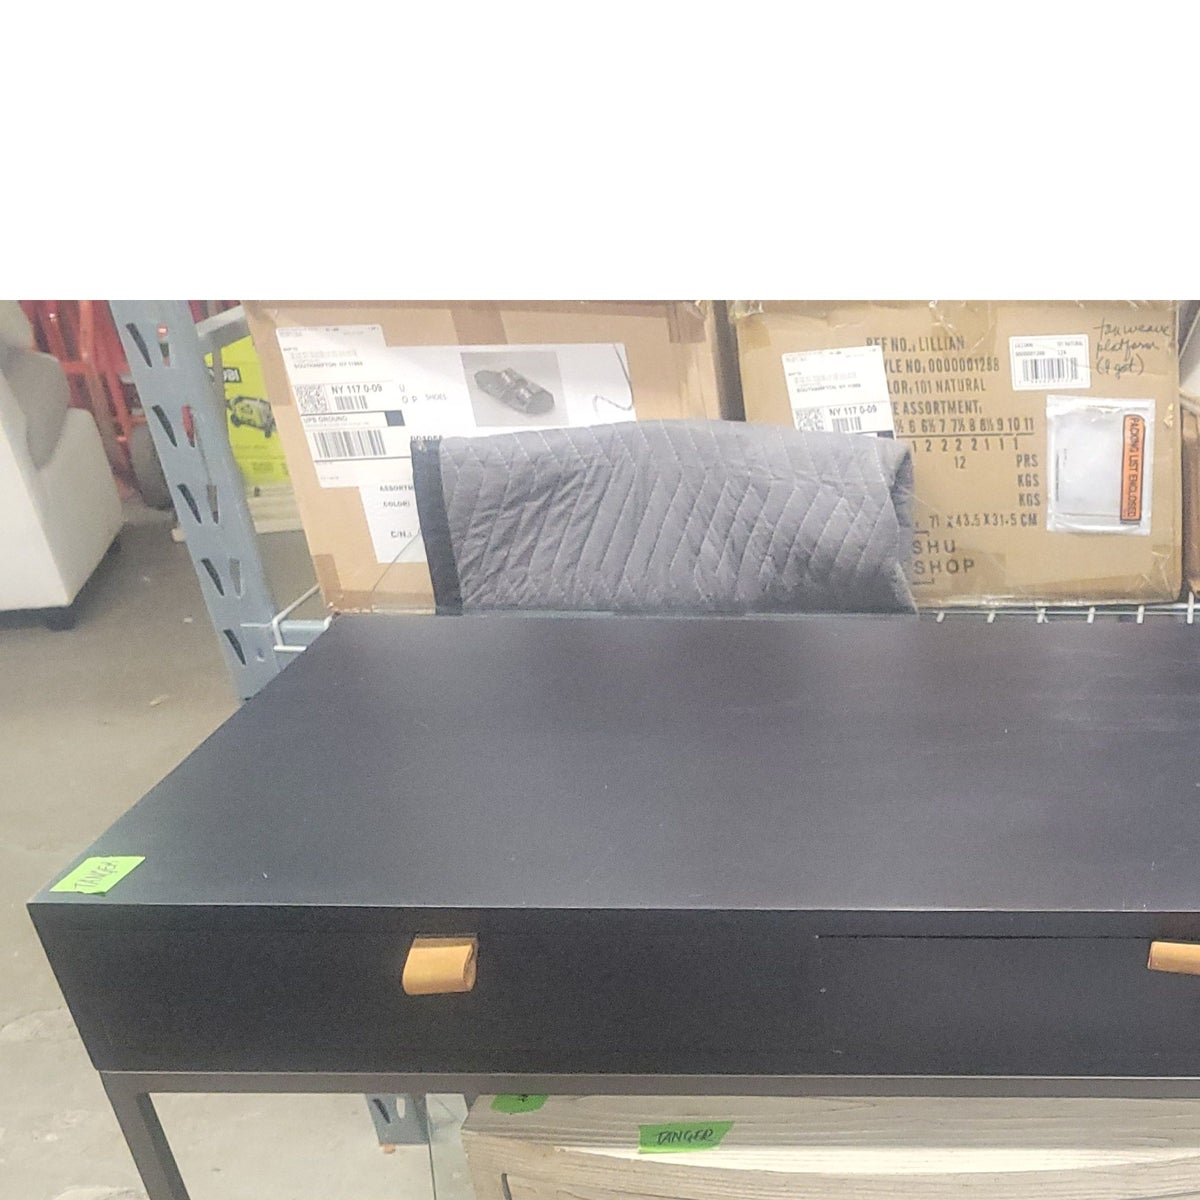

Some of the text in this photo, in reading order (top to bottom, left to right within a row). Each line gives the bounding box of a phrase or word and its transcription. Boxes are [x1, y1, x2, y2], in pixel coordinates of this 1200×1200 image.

[919, 336, 965, 351] LILLIAN
[332, 386, 344, 394] NY
[915, 381, 932, 395] 101
[936, 379, 986, 393] NATURAL
[829, 408, 841, 416] NY
[909, 420, 916, 433] 6
[939, 419, 946, 432] 7
[997, 418, 1004, 431] 9
[1008, 417, 1020, 431] 10
[1025, 417, 1034, 431] 11
[926, 439, 932, 452] 2
[942, 439, 948, 452] 2
[955, 438, 962, 451] 2
[971, 438, 978, 451] 2
[954, 454, 1038, 469] 12 PRS
[1129, 455, 1138, 472] LIST
[1017, 474, 1039, 487] KGS
[1019, 493, 1041, 507] KGS
[912, 540, 956, 554] SHU
[913, 559, 975, 575] SHOP
